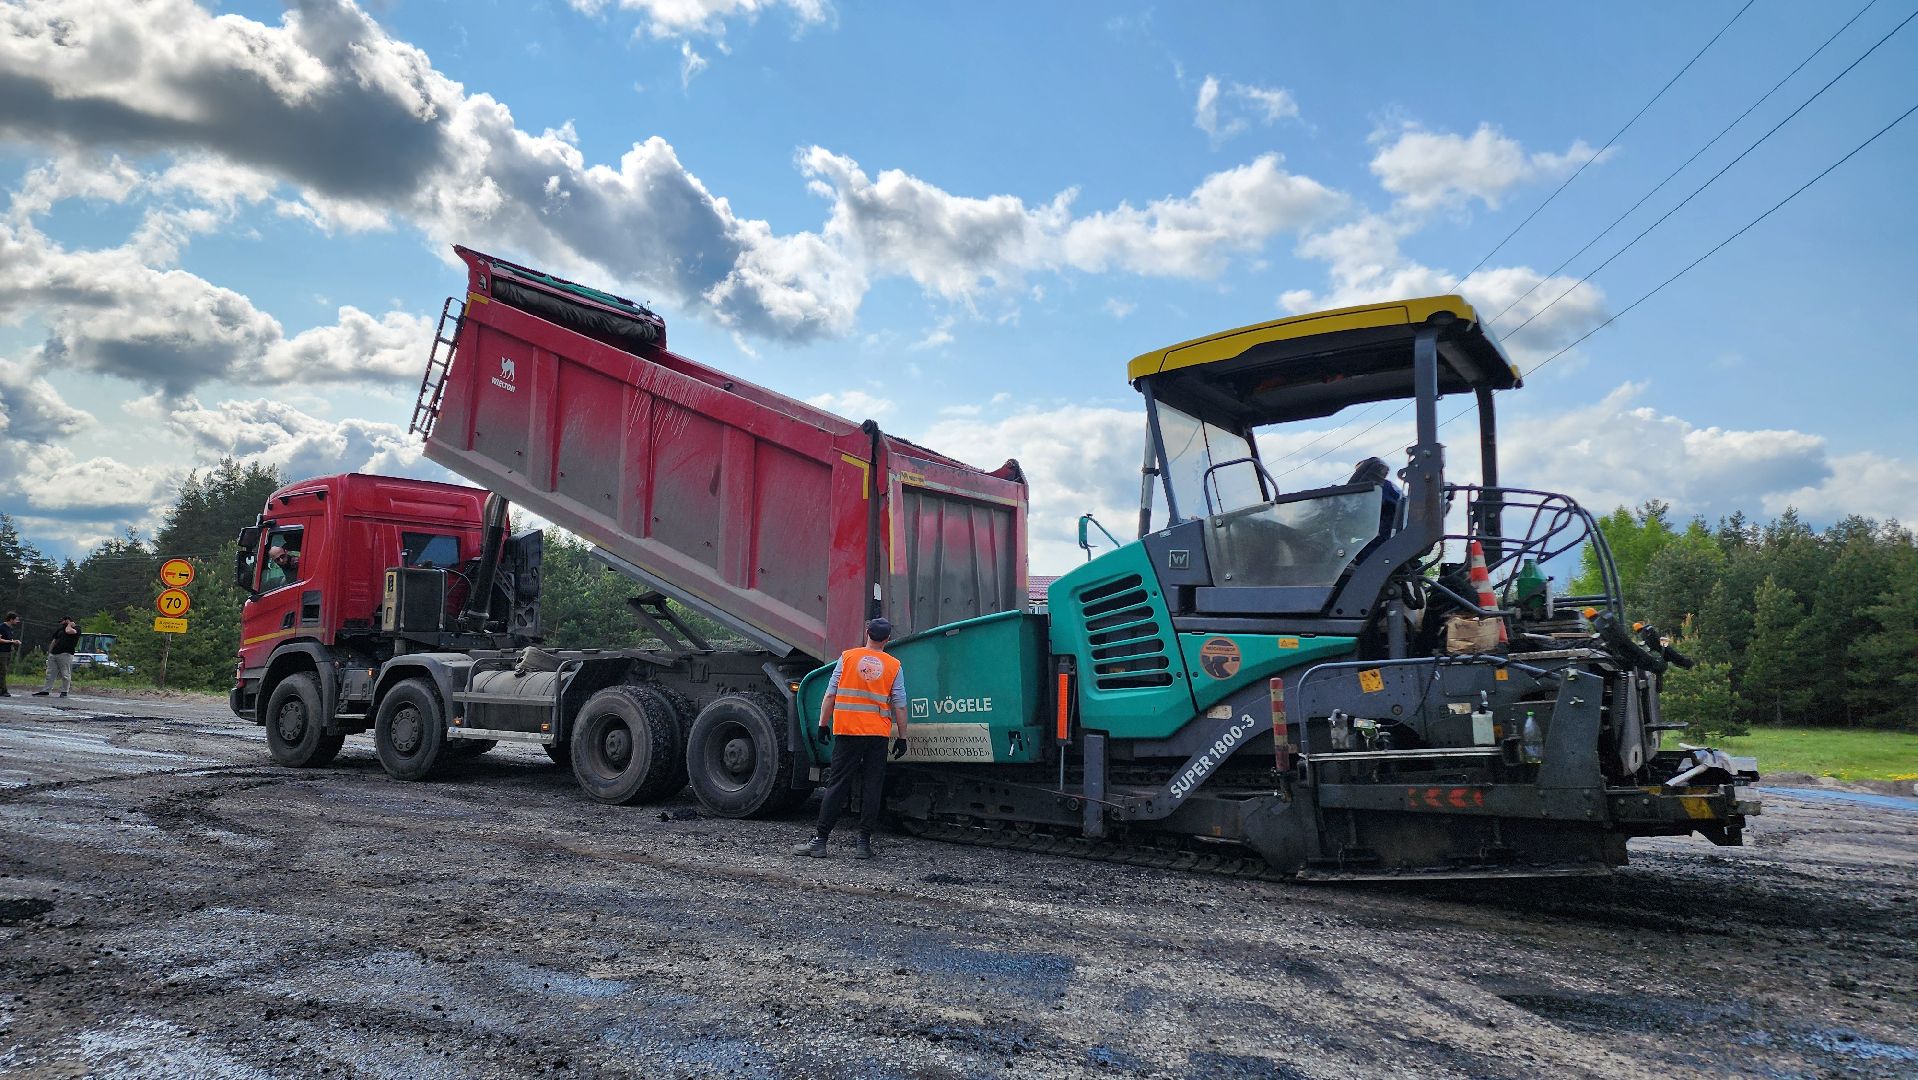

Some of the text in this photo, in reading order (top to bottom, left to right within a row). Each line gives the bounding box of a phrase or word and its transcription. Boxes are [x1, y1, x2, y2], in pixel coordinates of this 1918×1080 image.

[165, 597, 182, 609] 70
[933, 695, 993, 714] VÖGELE
[939, 736, 988, 744] ПРОГРАММА
[1170, 713, 1255, 799] SUPER 1800-3
